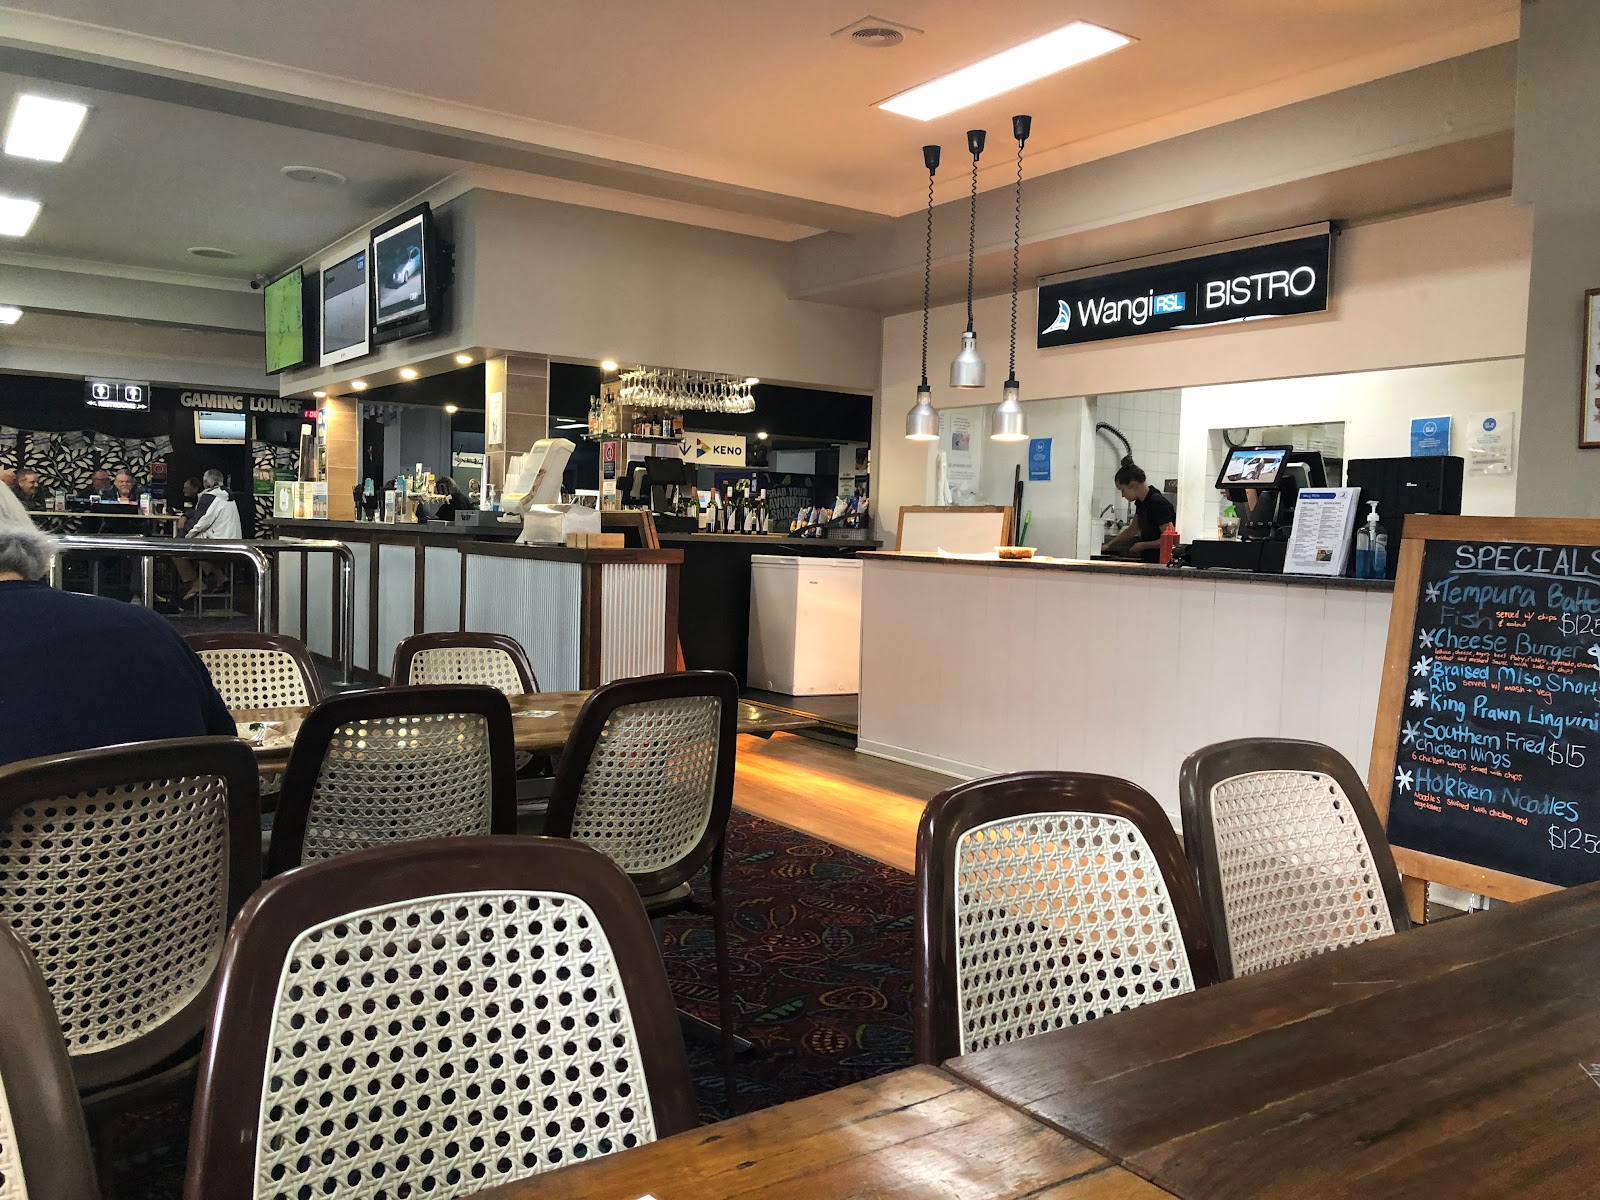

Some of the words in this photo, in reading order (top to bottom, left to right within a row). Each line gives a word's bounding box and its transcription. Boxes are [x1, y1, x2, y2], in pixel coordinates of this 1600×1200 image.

[1077, 288, 1154, 327] Wangi
[1155, 293, 1184, 312] RSL
[1205, 265, 1316, 309] BISTRO
[180, 391, 244, 410] GAMING
[713, 445, 742, 456] KENO
[1434, 574, 1537, 611] Tempura
[1440, 604, 1494, 631] Fish
[1495, 609, 1521, 619] served
[1537, 612, 1558, 623] chips
[1434, 626, 1508, 652] Cheese
[1514, 632, 1584, 661] Burger
[1432, 661, 1490, 680] Braised
[1497, 666, 1542, 687] Miso
[1545, 673, 1598, 696] Short
[1547, 664, 1556, 672] of
[1557, 666, 1574, 675] chips
[1428, 676, 1457, 693] Rib
[1462, 679, 1487, 689] served
[1504, 683, 1526, 694] mash
[1535, 688, 1553, 705] veg
[1429, 693, 1466, 723] King
[1473, 694, 1521, 725] Prawn
[1422, 716, 1501, 751] Southern
[1505, 731, 1546, 756] Fried
[1411, 750, 1418, 760] 6
[1418, 752, 1445, 765] chicken
[1446, 760, 1467, 773] wings
[1503, 771, 1523, 782] chips
[1470, 745, 1512, 770] Wings
[1546, 740, 1587, 768] $15
[1413, 791, 1441, 804] Noodles
[1472, 804, 1488, 815] with
[1488, 807, 1513, 821] chicken
[1501, 786, 1580, 823] Noodles
